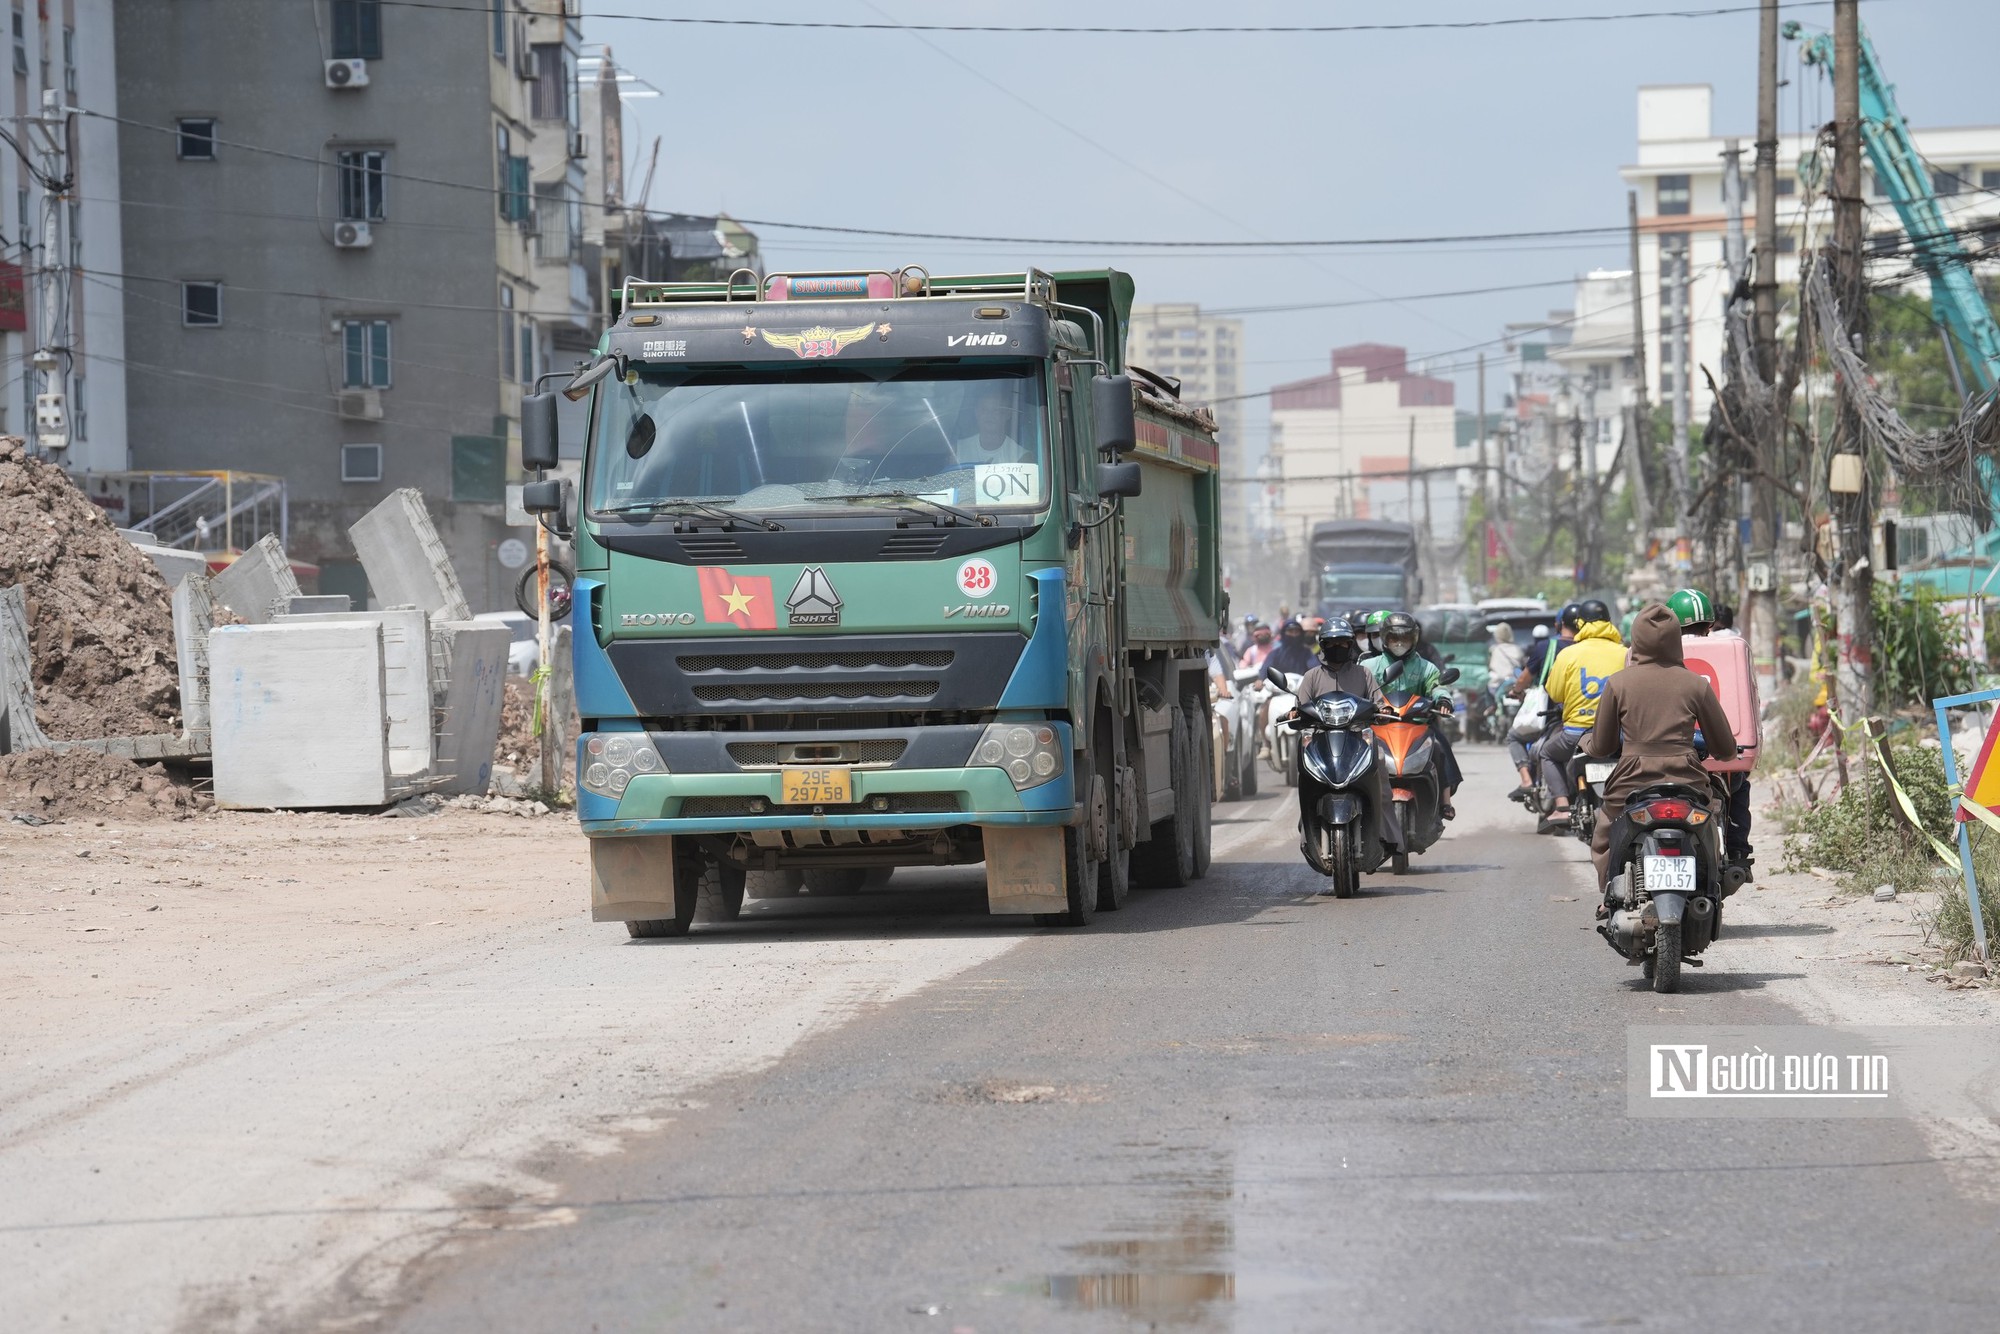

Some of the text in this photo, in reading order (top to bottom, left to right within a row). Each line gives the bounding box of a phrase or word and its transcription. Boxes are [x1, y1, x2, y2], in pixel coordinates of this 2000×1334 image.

[795, 279, 862, 293] SINOTRUK
[643, 340, 686, 351] 中国重汽
[804, 340, 834, 358] 23
[642, 350, 686, 358] SINOTRUK
[982, 473, 1032, 502] QN
[963, 566, 991, 589] 23
[620, 612, 696, 627] HOWO
[791, 614, 837, 624] CNHTC
[801, 770, 831, 785] 29E
[790, 786, 843, 802] 297.58
[1652, 858, 1688, 873] 29-H2
[1648, 874, 1692, 889] 370.57
